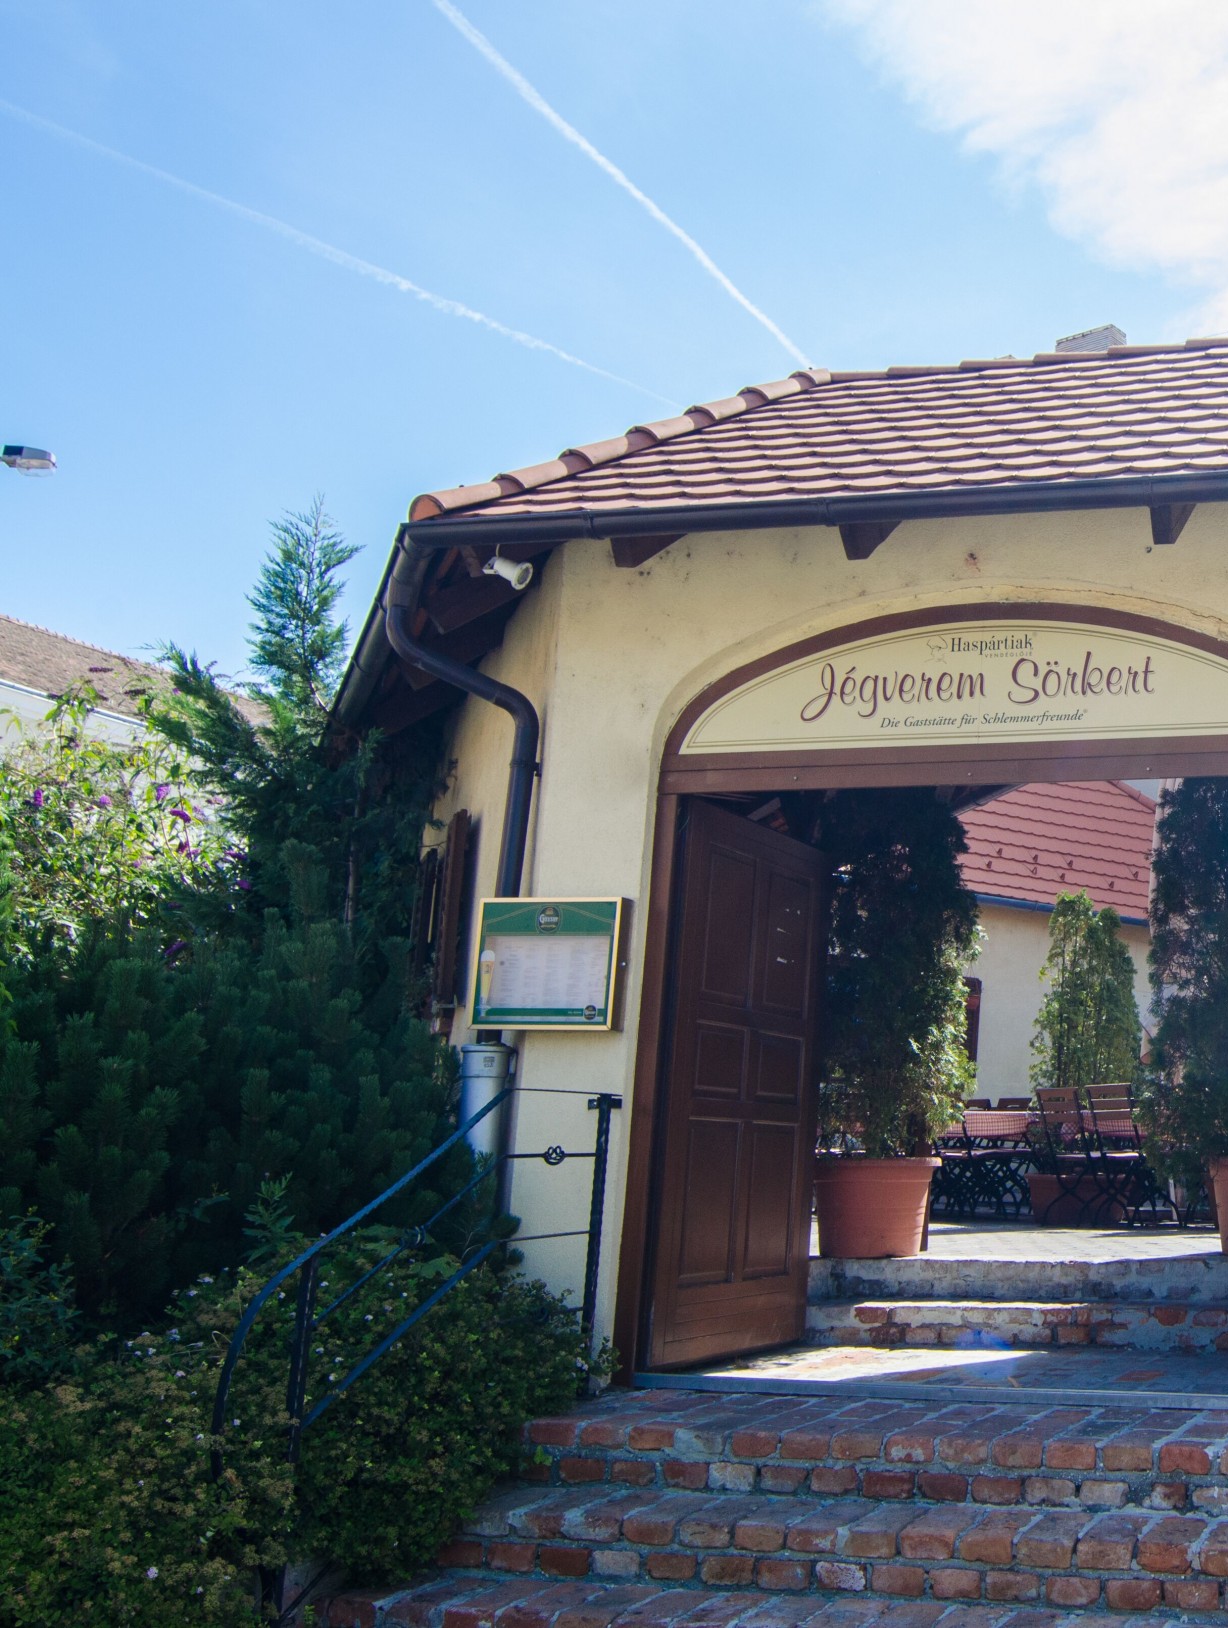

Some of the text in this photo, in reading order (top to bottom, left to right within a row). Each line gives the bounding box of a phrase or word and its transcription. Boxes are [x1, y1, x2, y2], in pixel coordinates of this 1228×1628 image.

[951, 634, 1033, 656] Haspártiak
[800, 651, 1156, 722] Jégverem Sörkert
[880, 717, 900, 728] Die
[904, 715, 957, 727] Gaststätte
[957, 713, 978, 729] für
